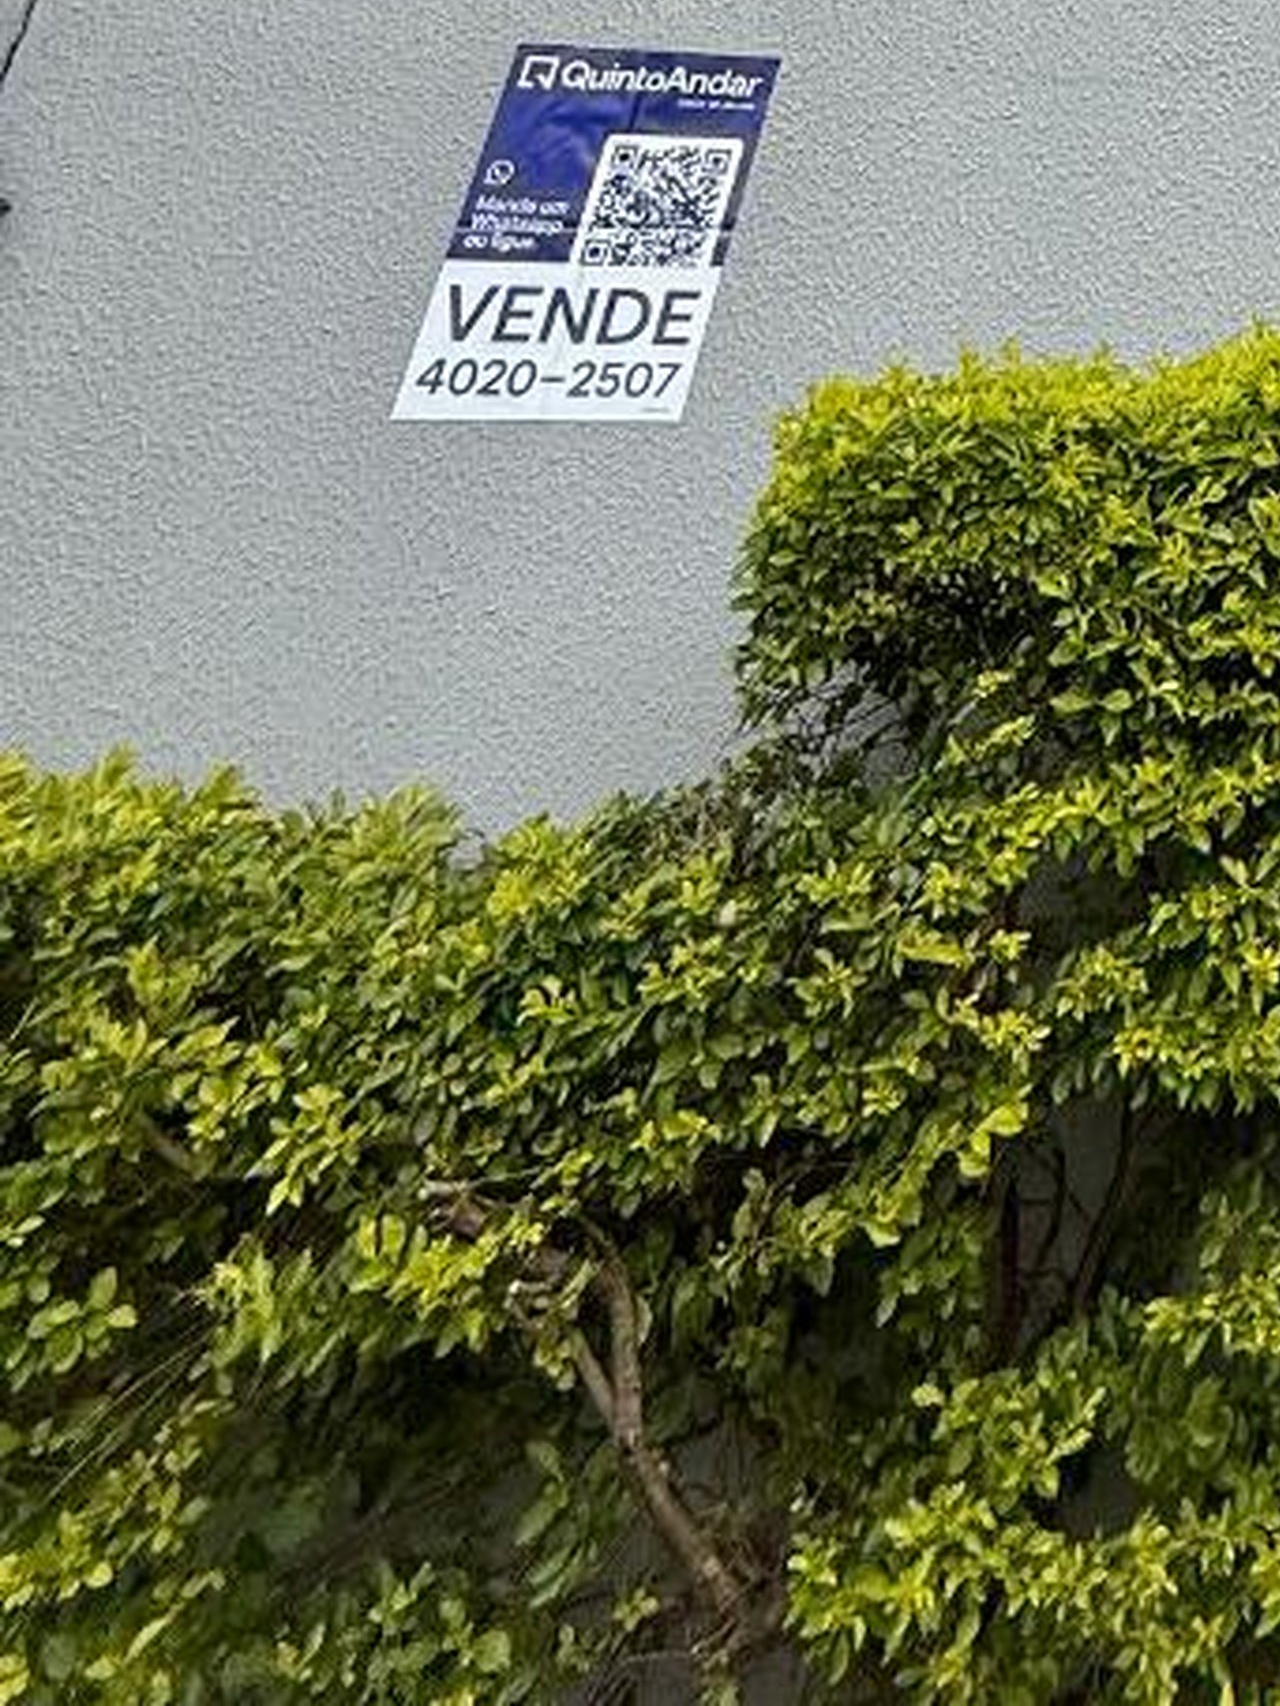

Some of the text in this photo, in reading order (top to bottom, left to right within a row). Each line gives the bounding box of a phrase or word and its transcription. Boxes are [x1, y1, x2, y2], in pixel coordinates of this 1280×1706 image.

[561, 59, 763, 97] QuintoAndar
[449, 284, 702, 345] VENDE
[415, 358, 682, 398] 4020-2507
